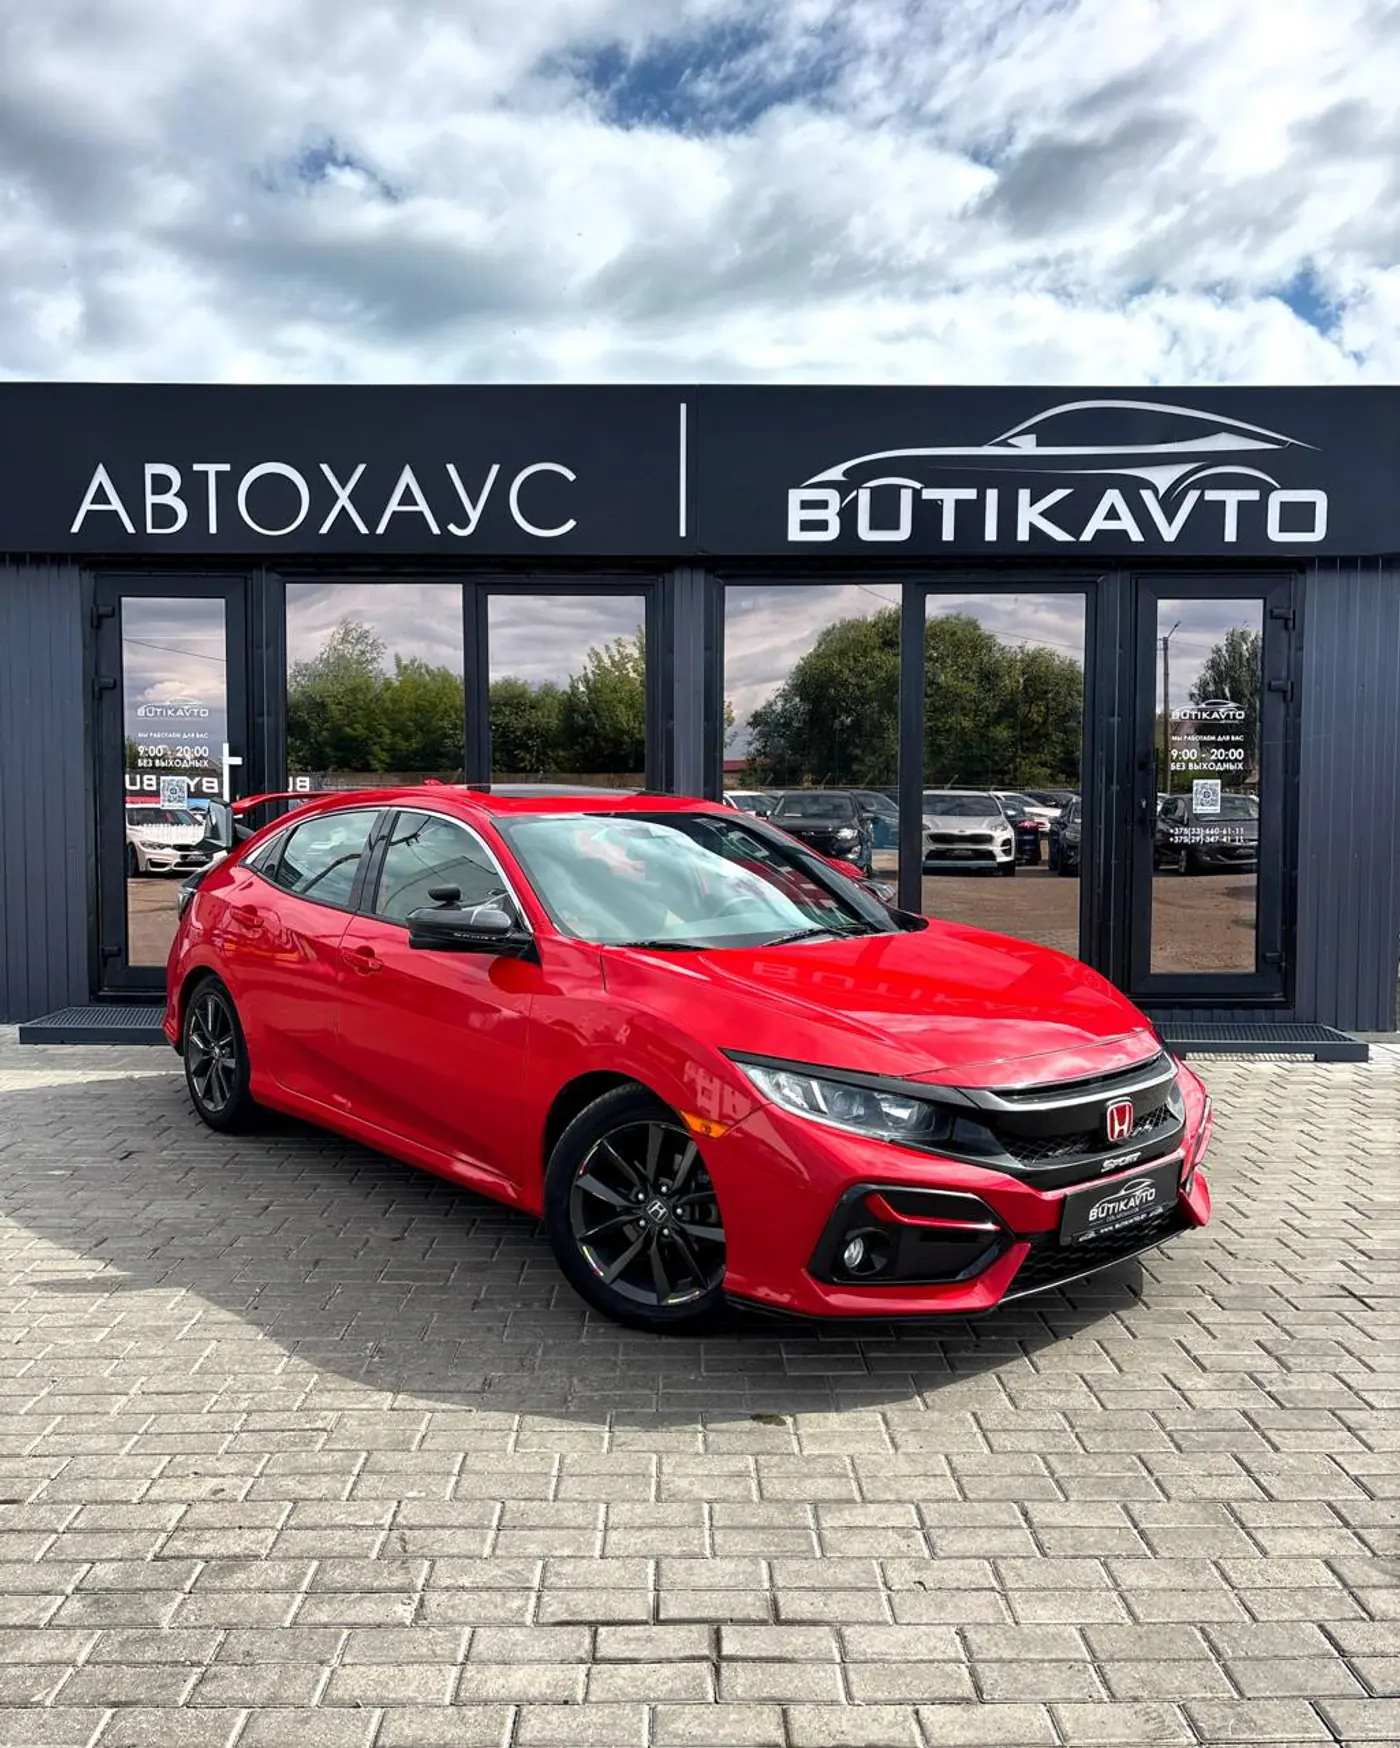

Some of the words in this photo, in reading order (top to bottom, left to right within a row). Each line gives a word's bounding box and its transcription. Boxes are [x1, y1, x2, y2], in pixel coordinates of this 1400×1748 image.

[71, 462, 577, 537] АВТОХАУС
[788, 488, 1328, 542] BUTIKAVTO
[137, 707, 209, 717] BUTIKAVTO
[1171, 710, 1245, 720] BUTIKAVTO
[138, 745, 164, 757] 9:00
[176, 745, 209, 757] 20:00
[1171, 749, 1198, 760] 9:00
[1210, 749, 1245, 760] 20:00
[138, 759, 152, 767] БЕЗ
[155, 759, 209, 768] ВЫХОДНЫХ
[1170, 762, 1186, 771] БЕЗ
[1188, 762, 1244, 771] ВЫХОДНЫХ
[1088, 1188, 1156, 1221] BUTIKAVTO
